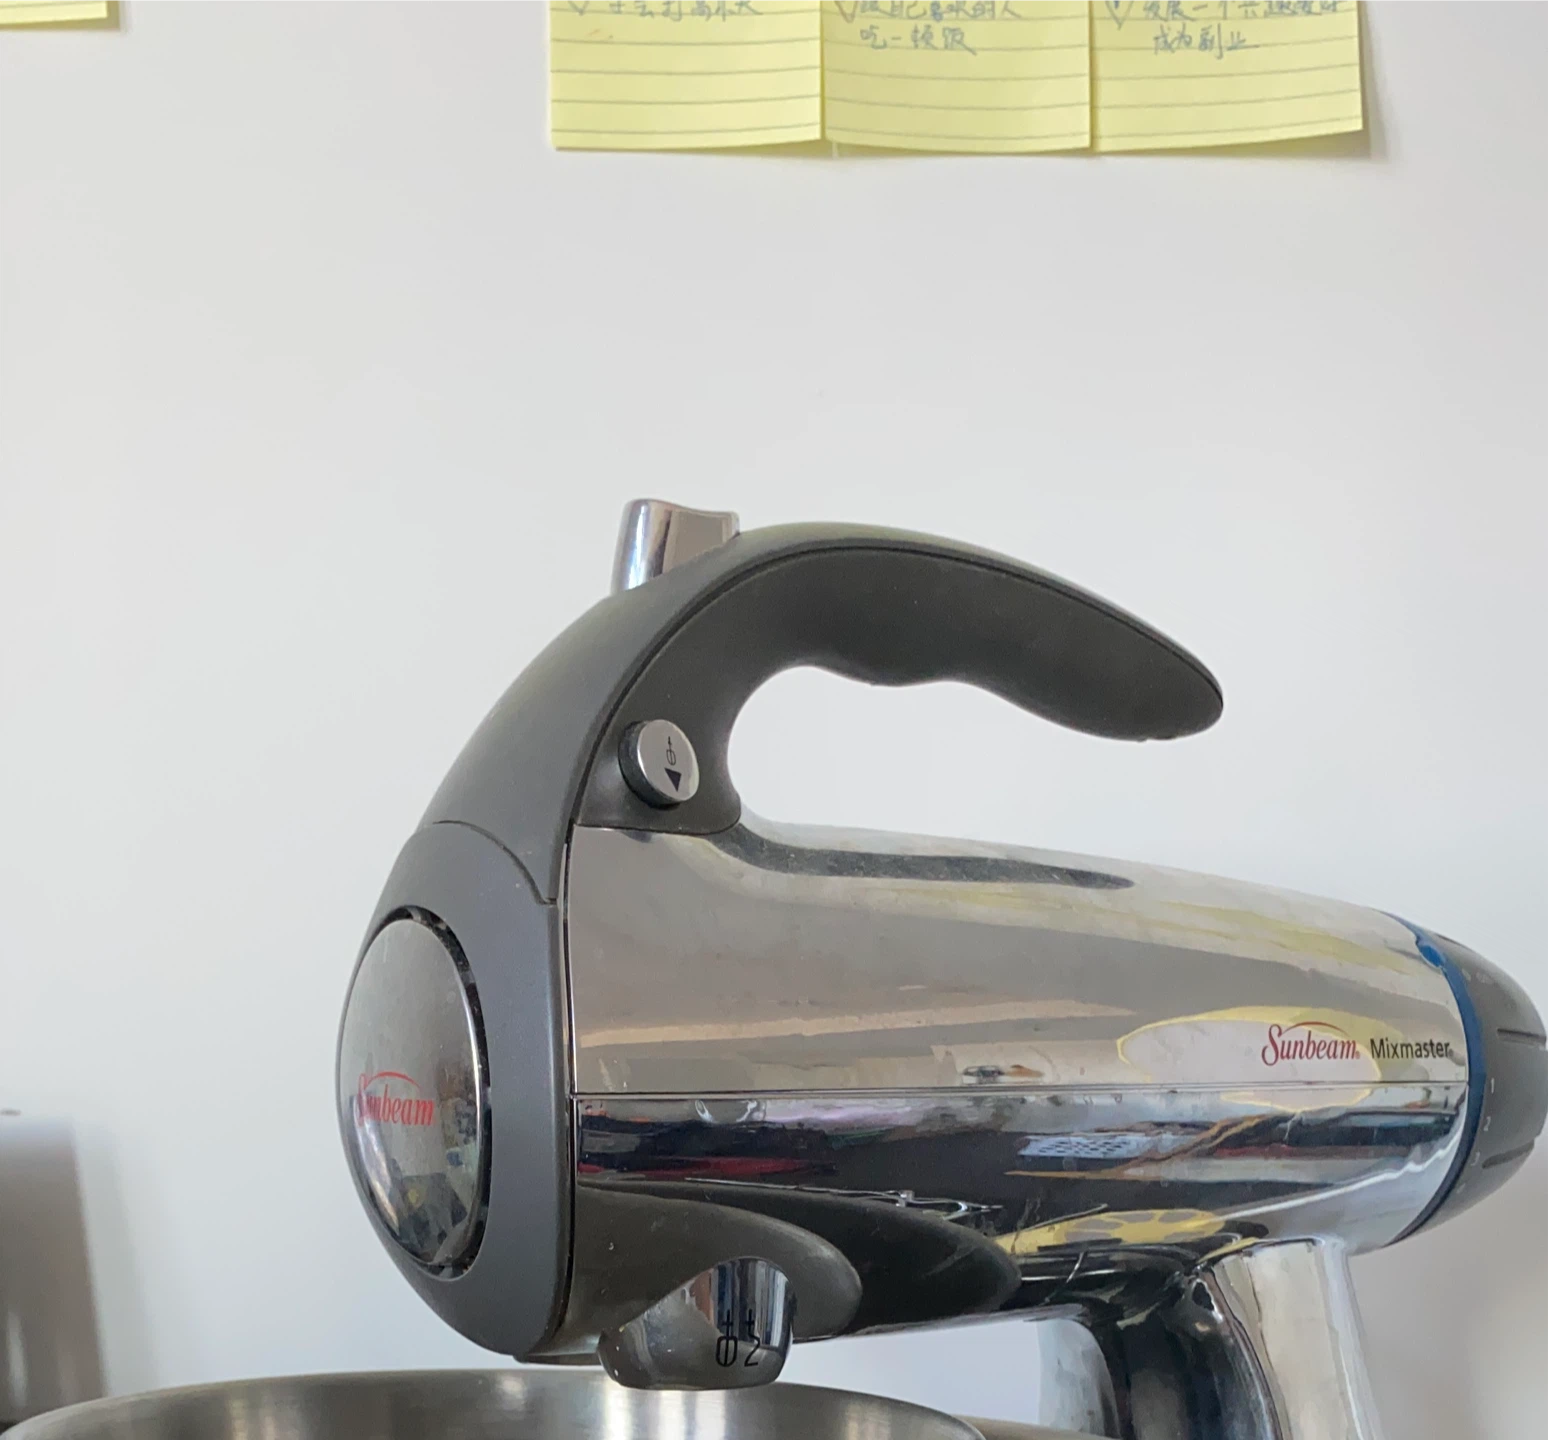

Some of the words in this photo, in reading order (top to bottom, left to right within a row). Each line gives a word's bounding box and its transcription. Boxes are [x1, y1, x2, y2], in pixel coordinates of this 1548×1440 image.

[1153, 22, 1260, 60] 成为副业
[1261, 1021, 1358, 1067] Sunbeam
[1370, 1037, 1451, 1061] Mixmaster
